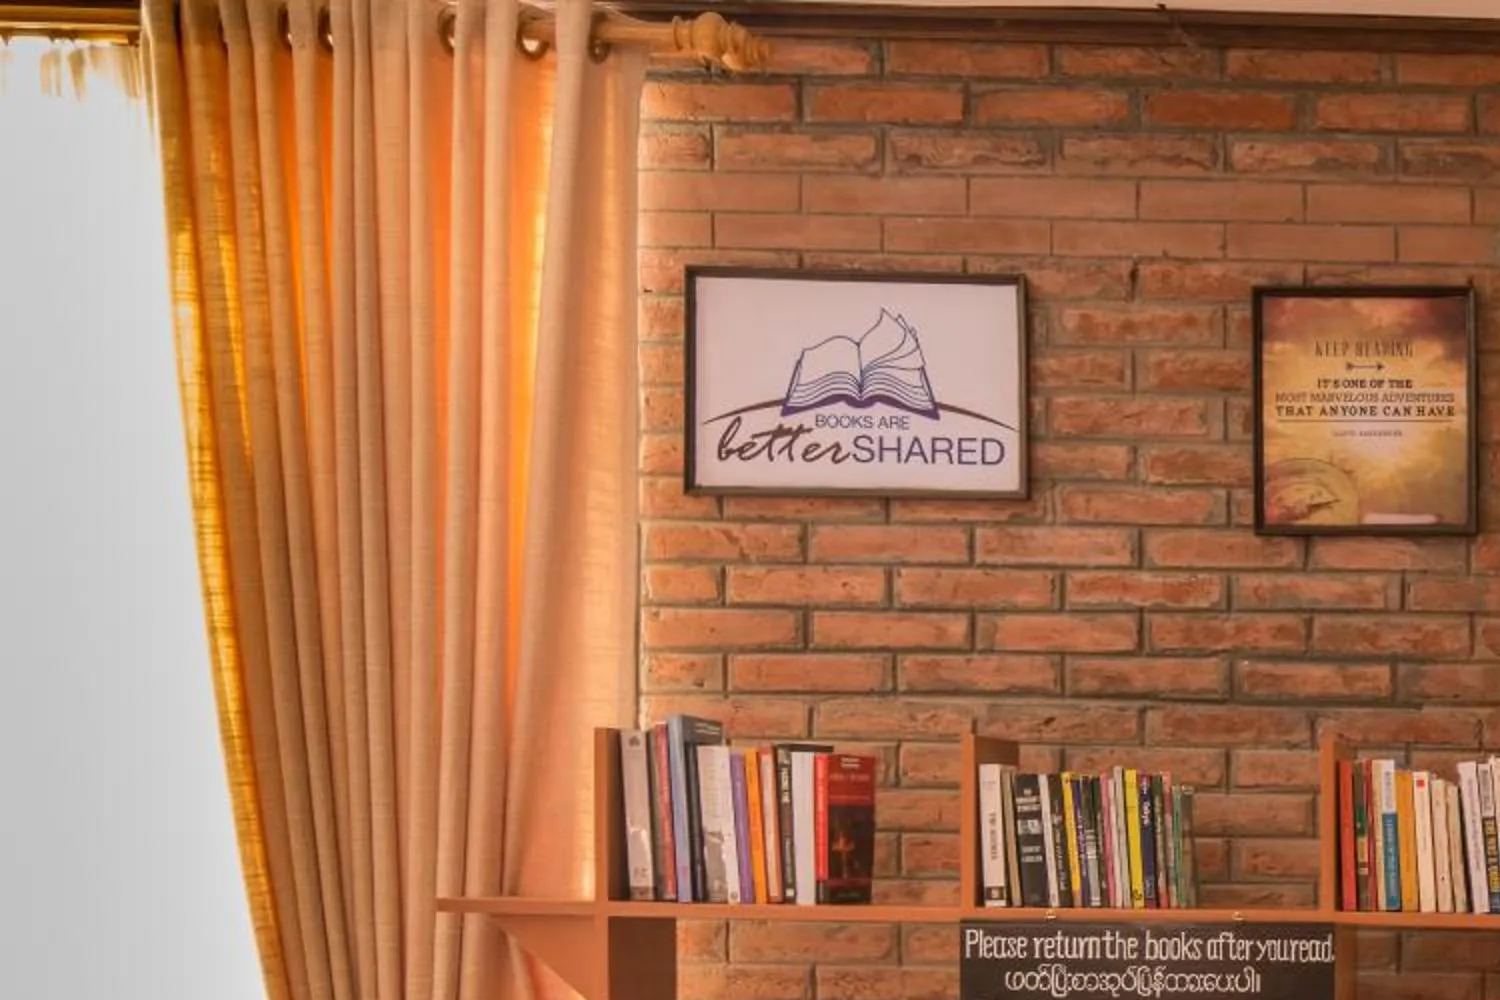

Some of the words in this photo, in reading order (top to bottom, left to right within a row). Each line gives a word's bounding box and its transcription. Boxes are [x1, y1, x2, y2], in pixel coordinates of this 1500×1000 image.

[1342, 379, 1368, 389] ONE
[1369, 379, 1385, 389] OF
[1388, 379, 1413, 389] THE
[1276, 406, 1312, 417] THAT
[1319, 406, 1377, 417] ANYONE
[1383, 406, 1412, 417] CAN
[1416, 406, 1455, 417] HAVE
[815, 414, 873, 429] BOOKS
[877, 415, 910, 430] ARE
[965, 929, 1028, 959] Please
[1032, 930, 1100, 959] return
[1101, 929, 1139, 960] the
[1145, 929, 1203, 961] books
[1207, 932, 1254, 960] after
[1256, 939, 1289, 962] you
